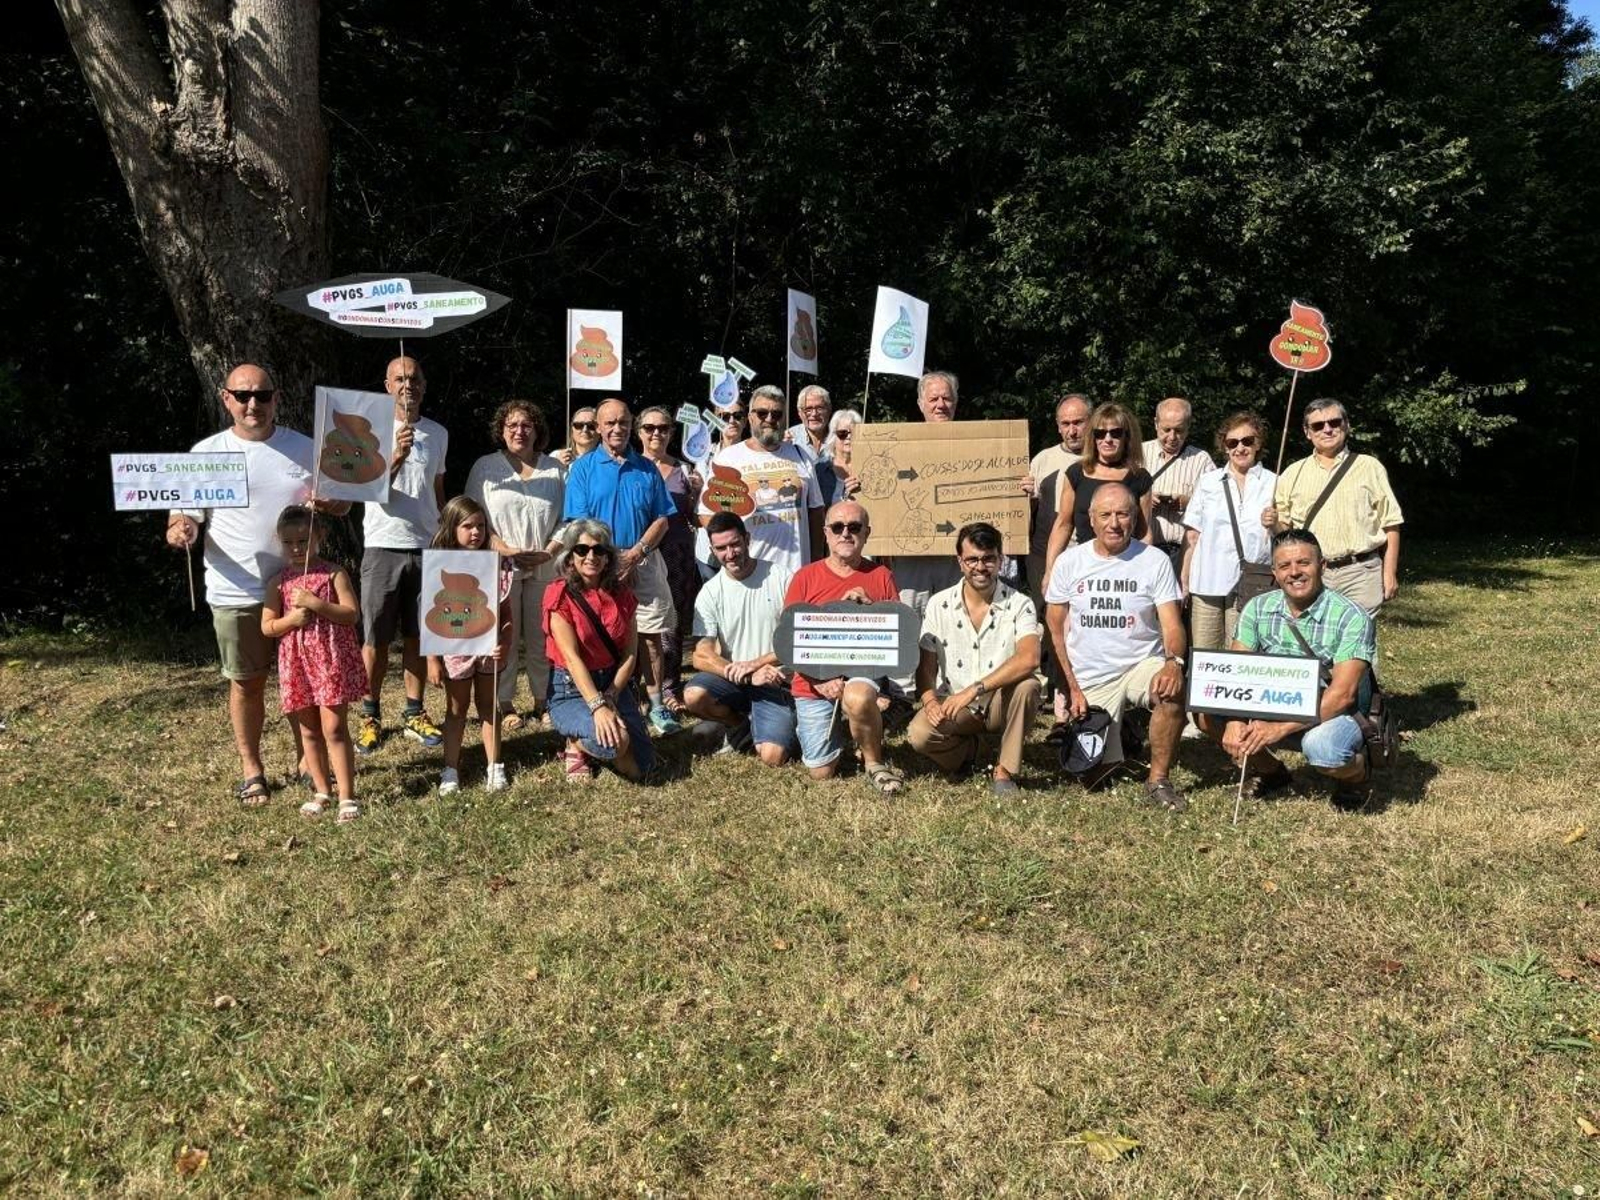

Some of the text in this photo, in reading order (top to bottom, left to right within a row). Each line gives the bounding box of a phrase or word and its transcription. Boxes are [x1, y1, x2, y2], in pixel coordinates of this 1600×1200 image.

[322, 282, 405, 304] #PVGS_AUGA
[387, 296, 485, 312] #PVGS_SANEAMENTO
[117, 462, 245, 476] #PVGS_SANEAMENTO
[125, 488, 236, 504] #PVGS_AUGA
[1097, 579, 1110, 592] LO
[1113, 578, 1138, 593] MÍO
[1090, 596, 1122, 610] PARA
[1080, 612, 1135, 629] CUÁNDO?
[1197, 661, 1310, 679] #PVGS_SANEAMENTO
[1203, 683, 1303, 707] #PVGS_AUGA
